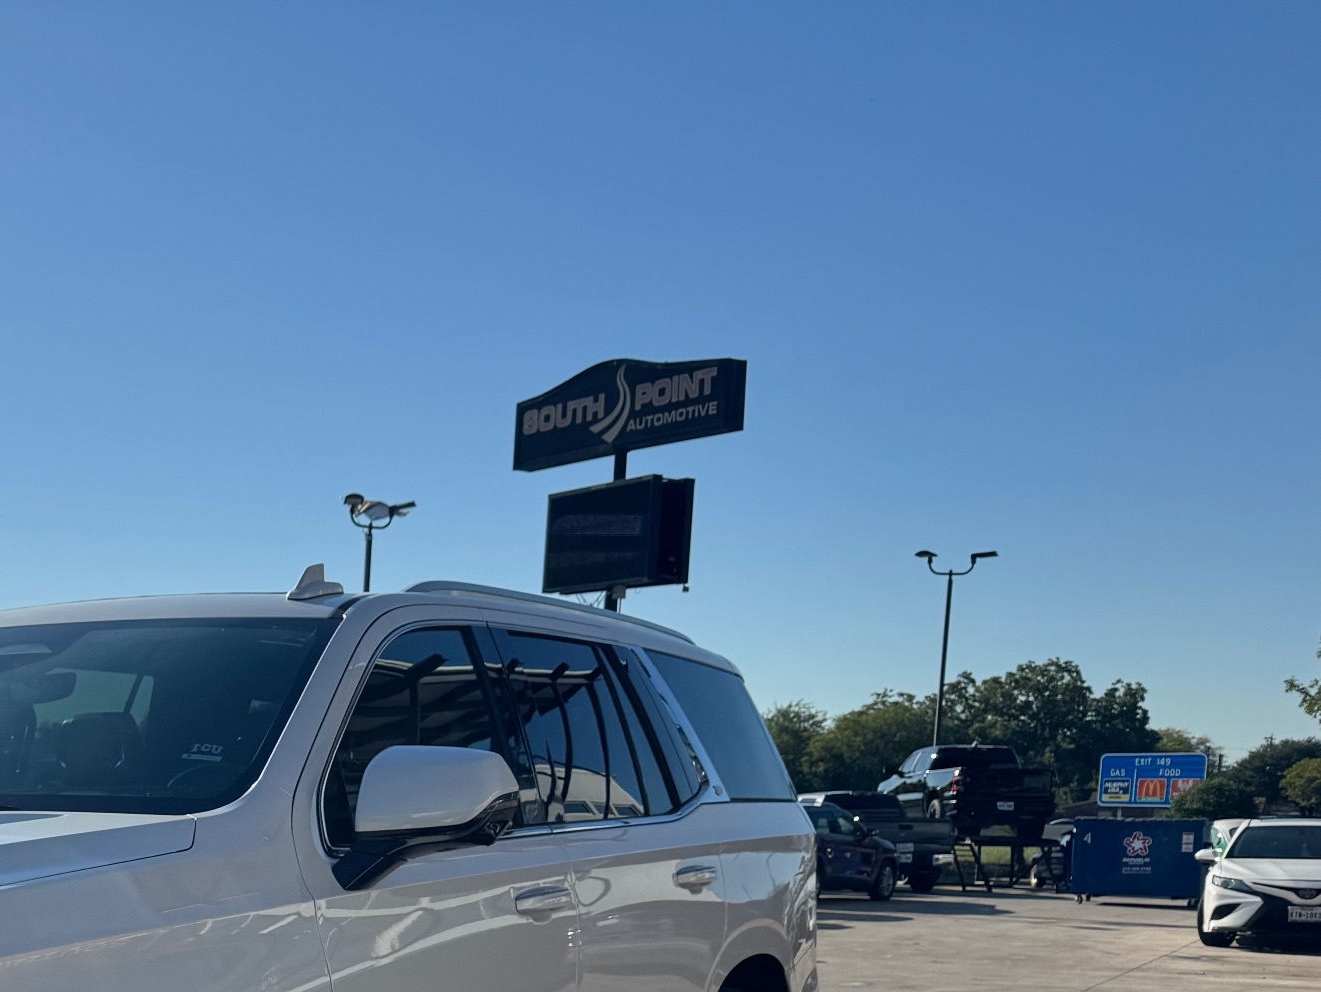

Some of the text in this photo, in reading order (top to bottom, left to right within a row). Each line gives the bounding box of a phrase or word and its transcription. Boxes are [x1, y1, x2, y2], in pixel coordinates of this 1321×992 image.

[522, 366, 718, 436] SOUTH POINT
[627, 401, 718, 432] AUTOMOTIVE
[1135, 757, 1171, 766] EXIT 149
[1110, 768, 1126, 777] GAS
[1159, 768, 1181, 777] FOOD
[1083, 832, 1092, 844] 4
